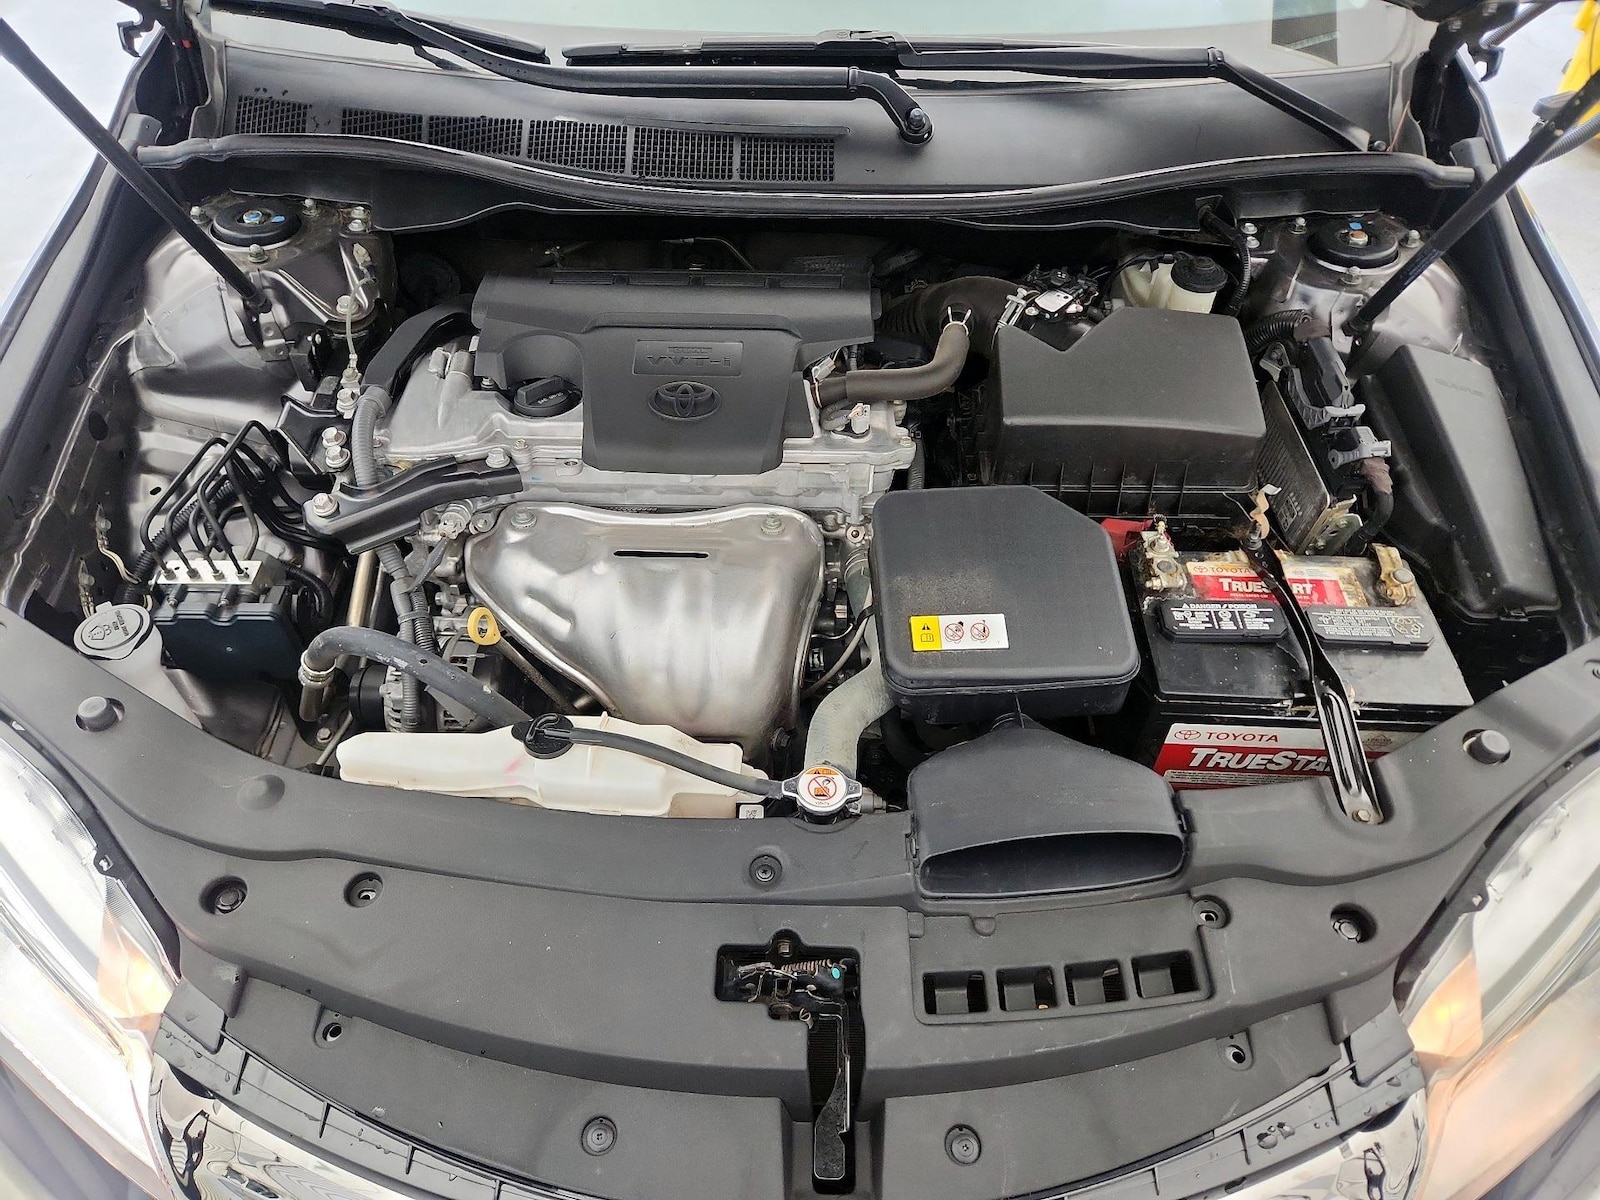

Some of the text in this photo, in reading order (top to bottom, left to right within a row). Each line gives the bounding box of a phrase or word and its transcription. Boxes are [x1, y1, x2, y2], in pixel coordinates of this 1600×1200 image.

[646, 355, 731, 367] VVT-i
[1210, 566, 1252, 574] TOYOTA
[1205, 731, 1279, 743] TOYOTA
